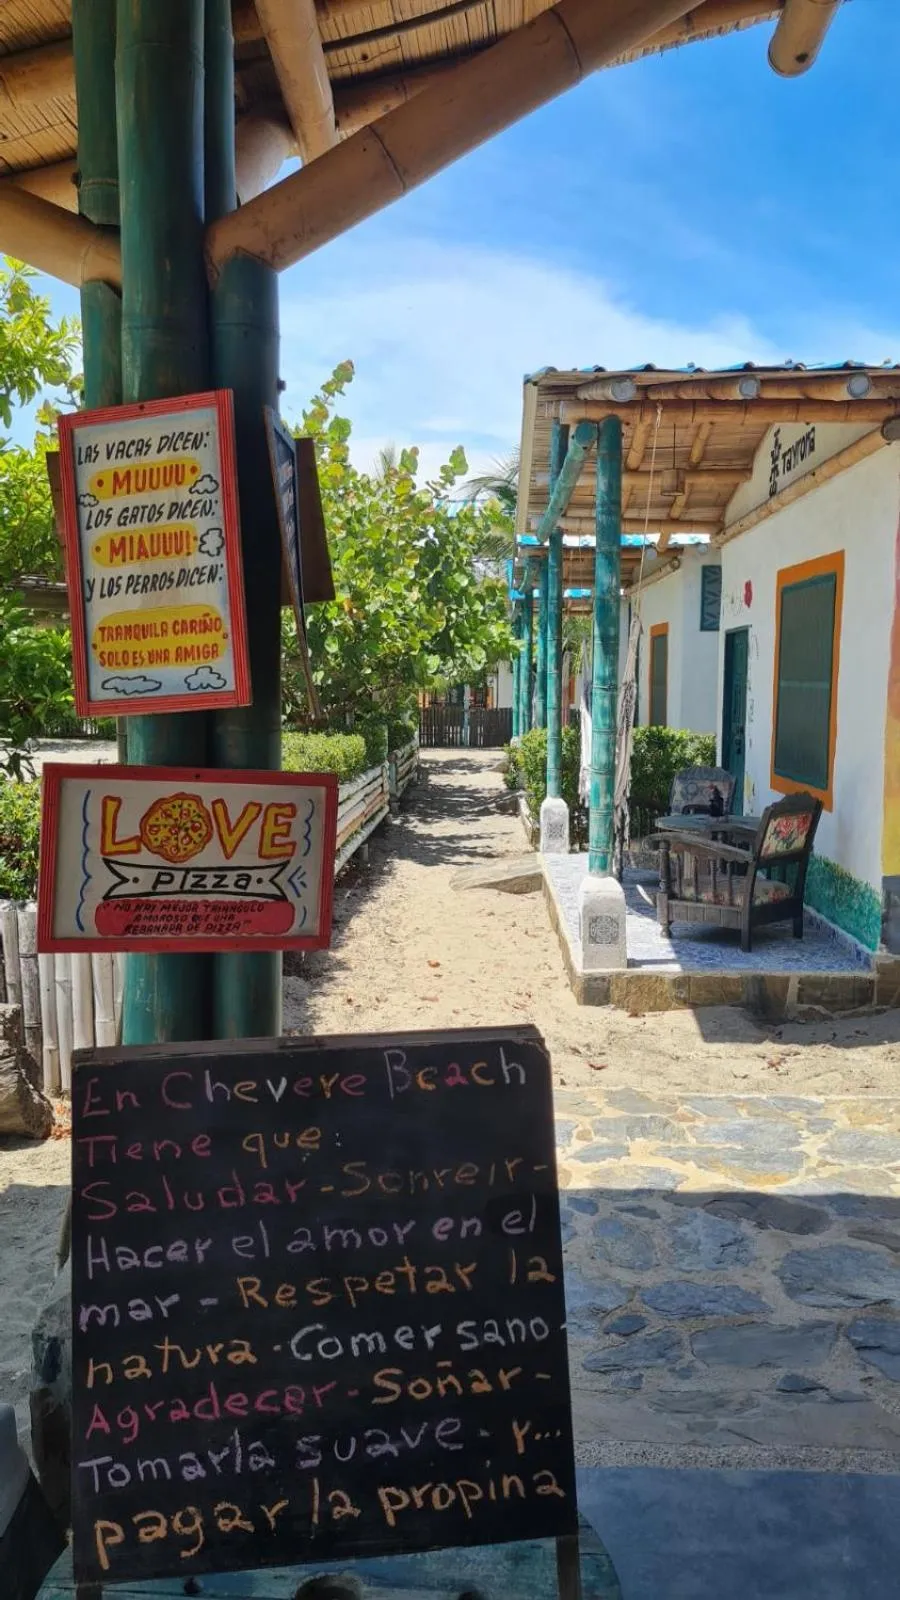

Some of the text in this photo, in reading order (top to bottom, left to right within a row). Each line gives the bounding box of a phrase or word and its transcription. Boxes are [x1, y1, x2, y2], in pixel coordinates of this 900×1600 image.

[78, 431, 210, 466] LAS VACAS DICEN:
[112, 463, 187, 497] MUUUU
[86, 499, 218, 531] LOS GATOS DICEN:
[100, 576, 122, 600] LOS
[124, 571, 175, 596] PERROS
[175, 563, 225, 589] DICEN:
[98, 612, 222, 643] TRANQUILA CARIÑO
[99, 642, 219, 669] SOLO ES UNA AMIGA
[100, 792, 298, 863] LOVE
[150, 867, 252, 892] pizza
[160, 903, 198, 913] MEJOR
[187, 923, 202, 932] DE
[82, 1047, 526, 1117] En Chevere Beach
[77, 1133, 212, 1167] Tiene
[81, 1169, 306, 1220] Saludar
[86, 1193, 537, 1280] Hacer el amor en el
[79, 1293, 180, 1333] mar
[237, 1255, 478, 1308] Respetar
[511, 1248, 556, 1285] la
[86, 1335, 258, 1389] natura
[290, 1323, 442, 1361] Comer
[85, 1381, 337, 1444] Agradecer
[371, 1361, 523, 1405] Soñar
[78, 1427, 275, 1493] Tomarla
[295, 1417, 464, 1469] suave
[94, 1460, 566, 1570] pagar la propina
